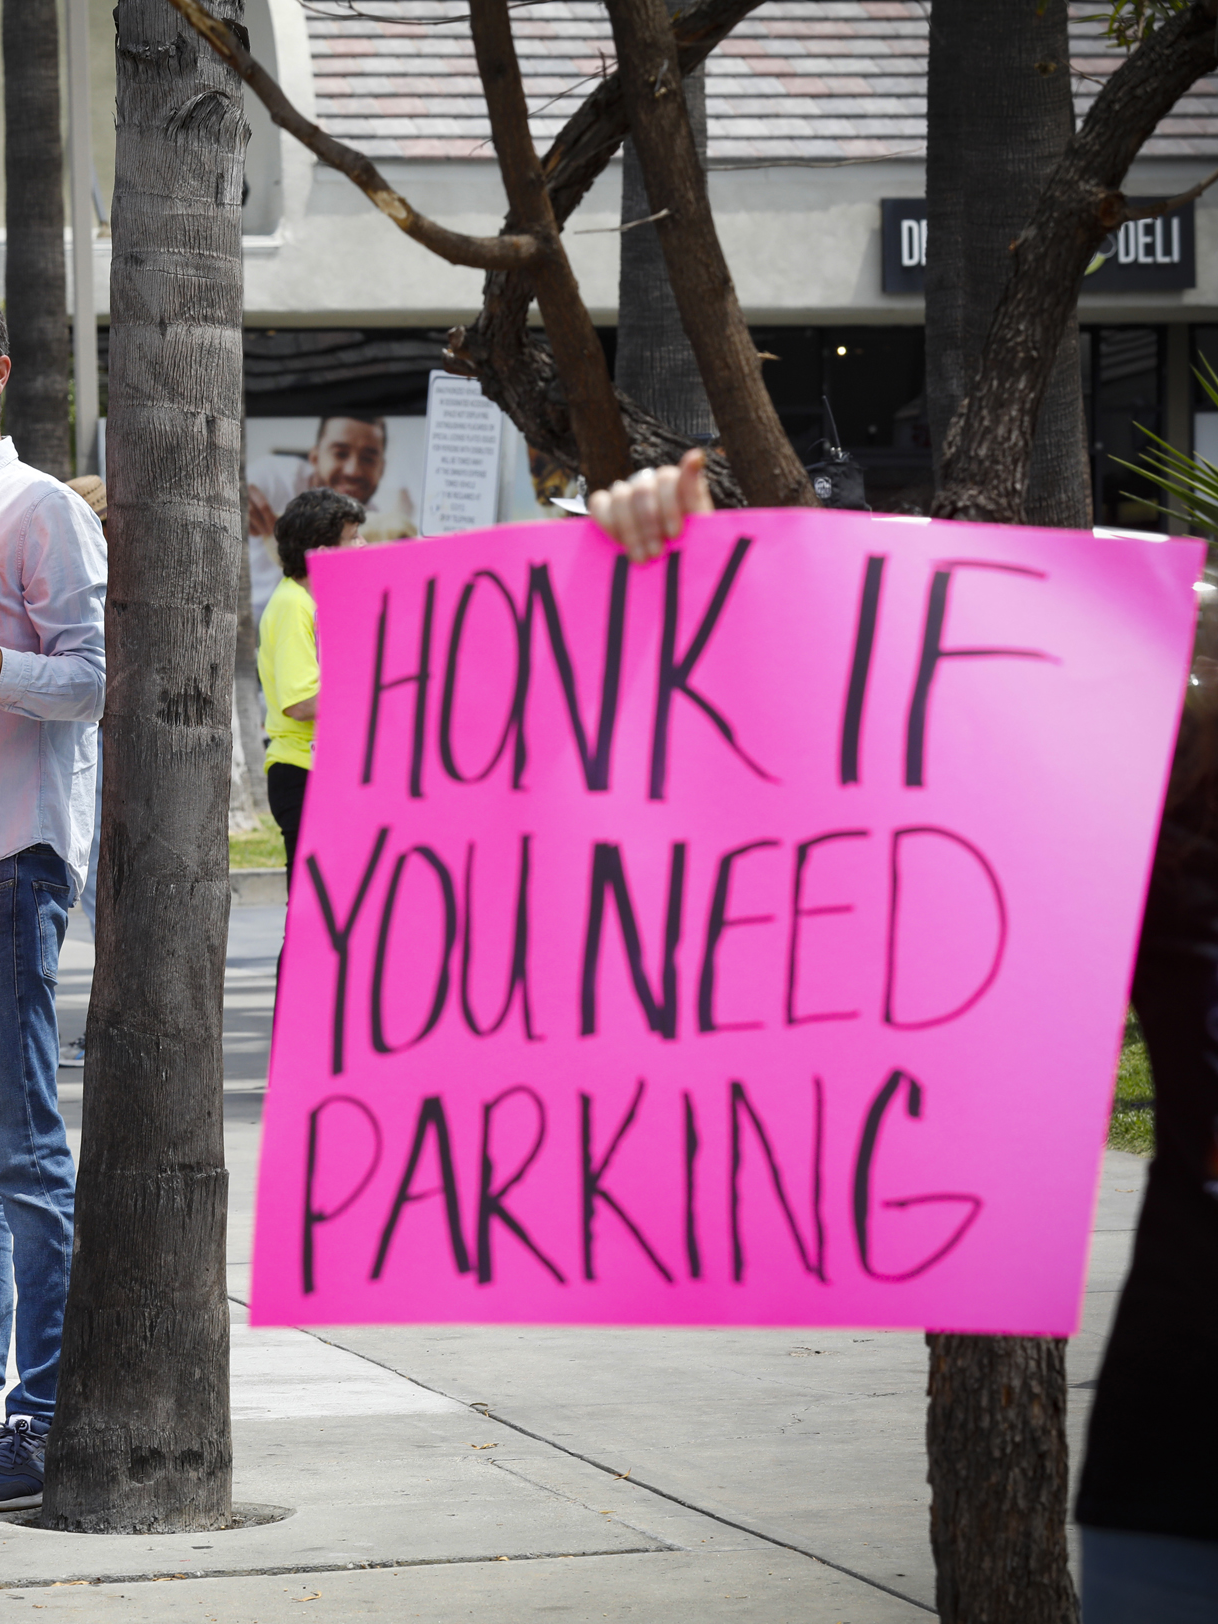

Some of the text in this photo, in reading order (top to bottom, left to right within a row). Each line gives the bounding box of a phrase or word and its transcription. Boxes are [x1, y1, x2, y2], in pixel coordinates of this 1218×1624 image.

[1117, 216, 1180, 264] DELI
[359, 538, 1062, 798] HONK IF
[305, 827, 1008, 1076] YOU NEED
[301, 1069, 982, 1295] PARKING
